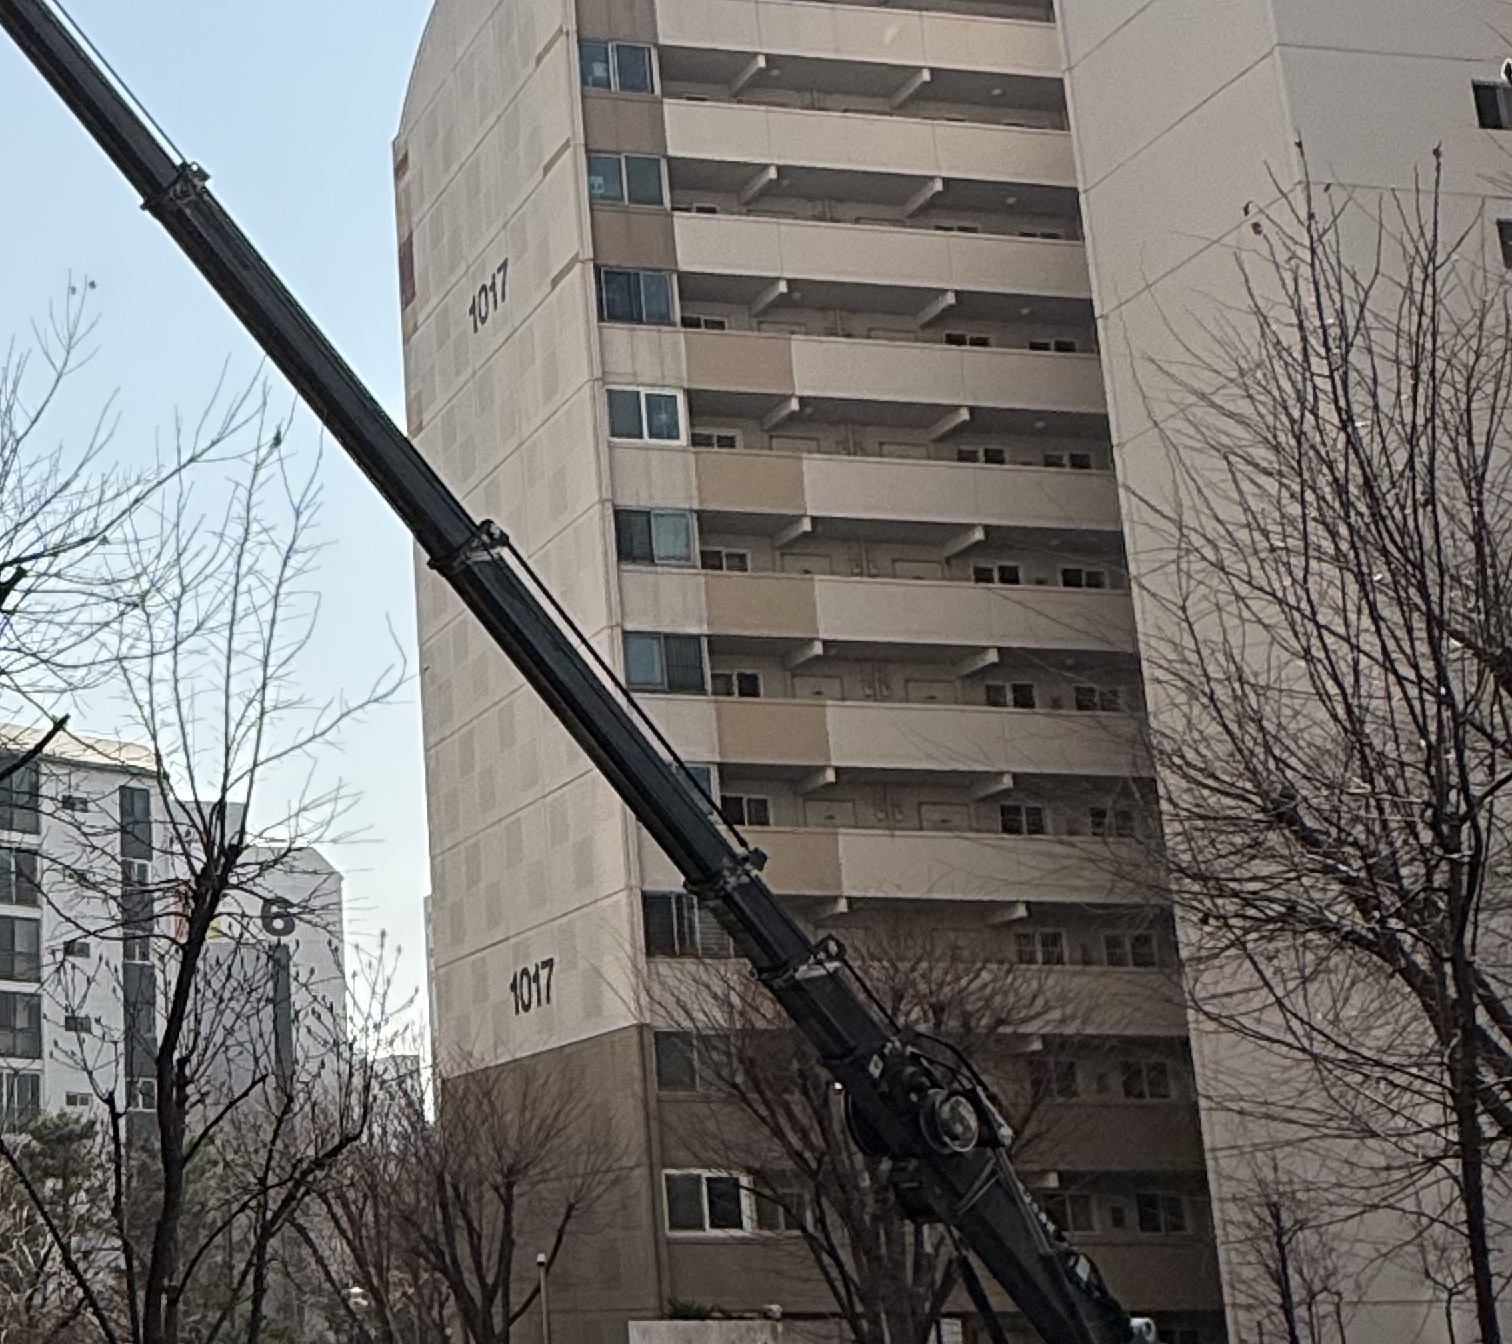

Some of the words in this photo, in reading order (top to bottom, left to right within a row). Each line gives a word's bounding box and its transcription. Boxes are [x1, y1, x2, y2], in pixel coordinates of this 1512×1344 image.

[468, 257, 509, 334] 1017
[261, 898, 295, 936] 6
[509, 957, 554, 1016] 1017
